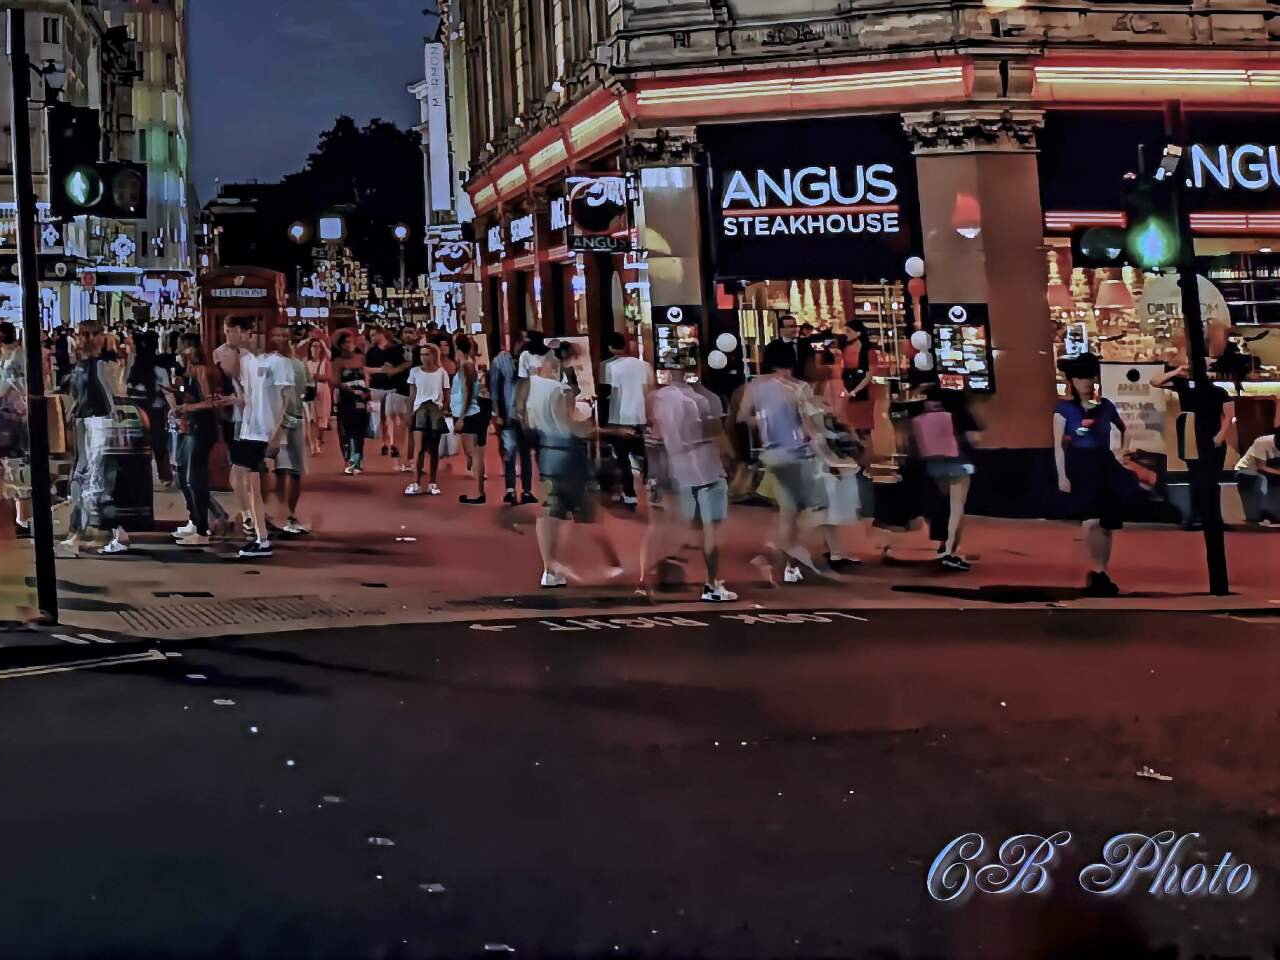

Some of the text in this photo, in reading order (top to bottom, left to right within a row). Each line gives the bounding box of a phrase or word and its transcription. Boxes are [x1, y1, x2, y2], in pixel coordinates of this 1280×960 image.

[431, 45, 442, 107] MRMON
[722, 163, 898, 208] ANGUS
[1185, 144, 1280, 189] NG
[573, 237, 626, 248] ANGUS
[723, 213, 900, 236] STEAKHOUSE
